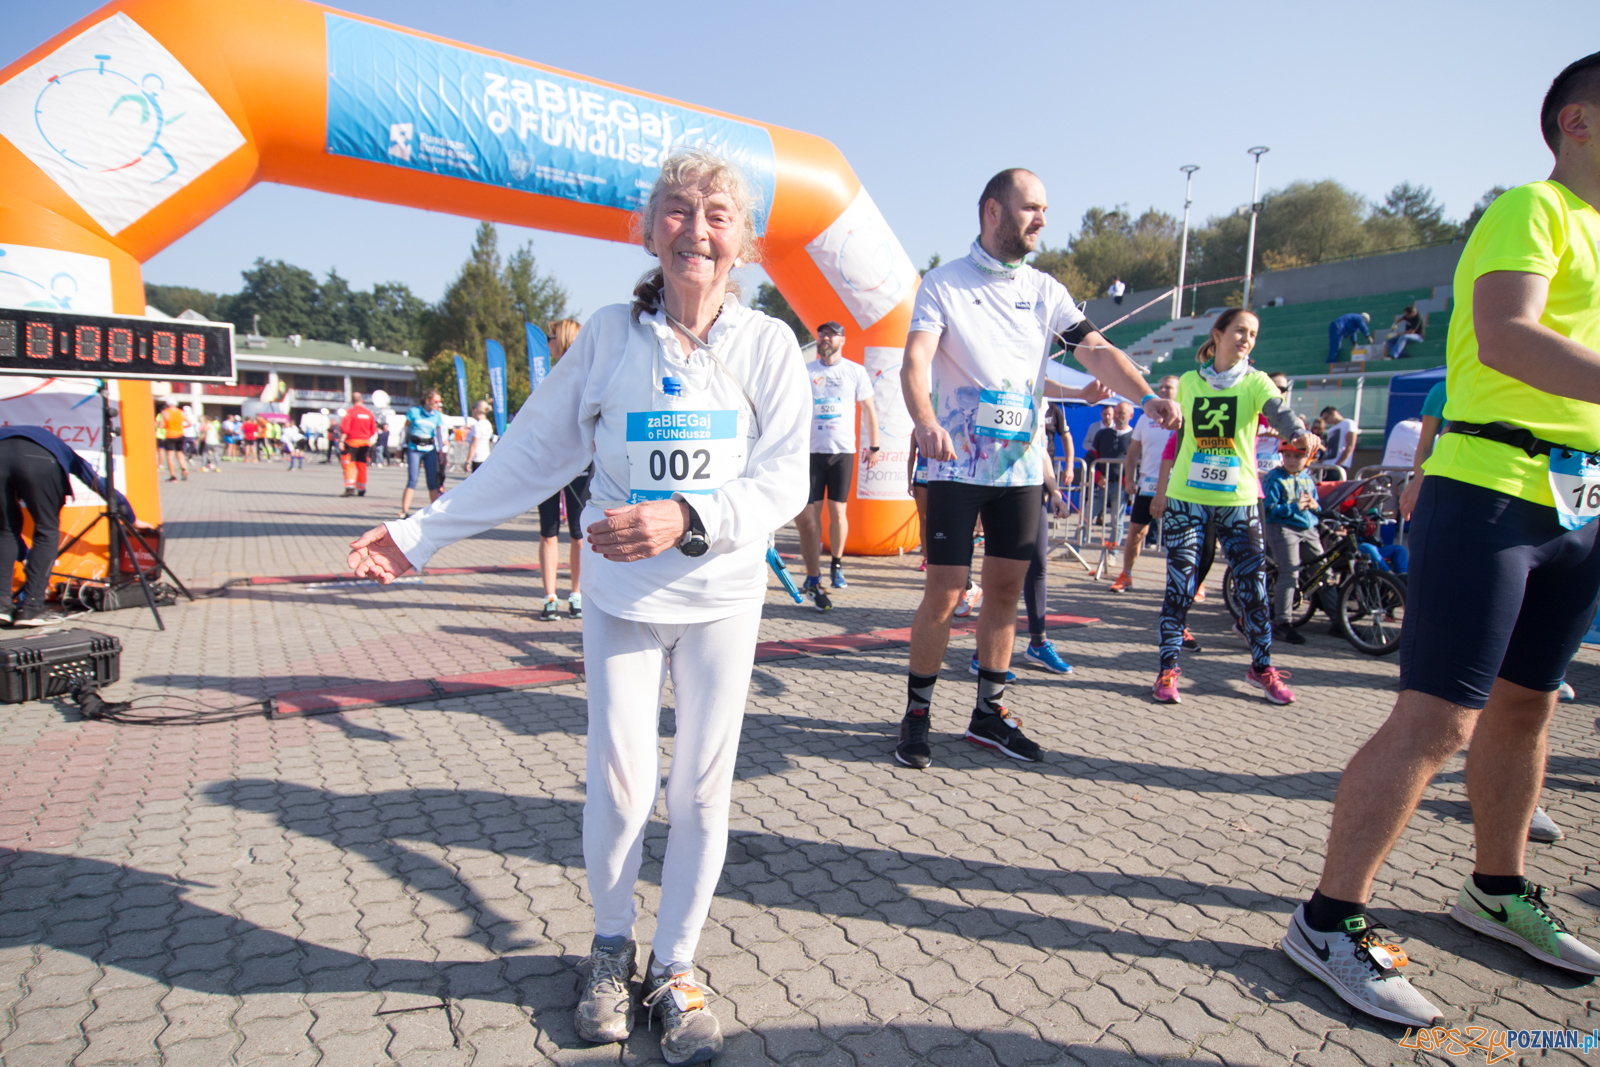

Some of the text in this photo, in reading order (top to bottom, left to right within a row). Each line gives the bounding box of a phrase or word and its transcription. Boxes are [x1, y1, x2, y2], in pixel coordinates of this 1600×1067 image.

[484, 71, 672, 148] zaBIEGaj
[487, 110, 508, 134] o
[821, 405, 835, 413] 520
[647, 414, 711, 430] zaBIEGaj
[994, 409, 1022, 426] 330
[648, 429, 711, 440] o FUNdusze
[1201, 437, 1228, 448] night
[649, 448, 711, 482] 002
[1201, 467, 1228, 481] 559
[1349, 919, 1364, 929] NIKE
